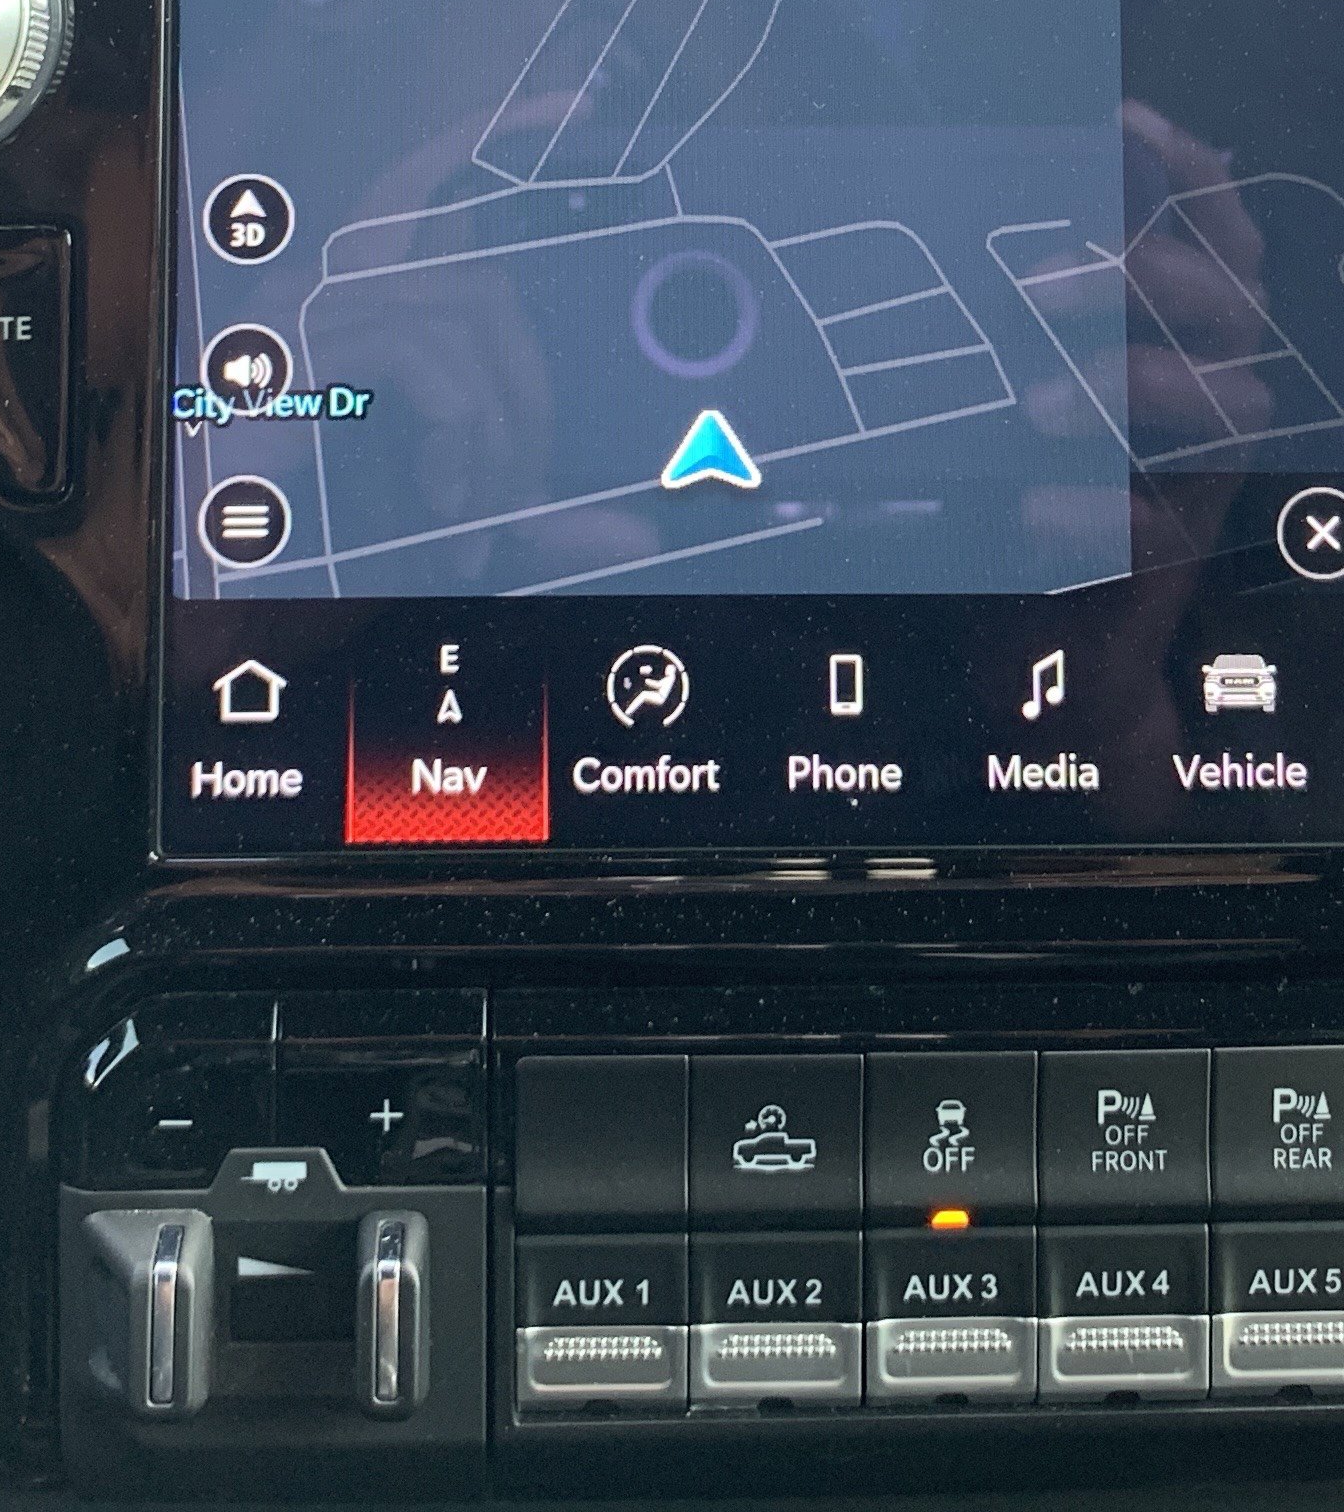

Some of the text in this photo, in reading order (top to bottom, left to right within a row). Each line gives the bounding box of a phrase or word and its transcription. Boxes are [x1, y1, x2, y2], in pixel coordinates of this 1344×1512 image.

[230, 223, 266, 248] 3D
[174, 388, 235, 425] City
[329, 387, 369, 416] Dr
[190, 761, 304, 797] Home
[411, 759, 487, 794] Nav
[573, 756, 720, 793] Comfort
[787, 755, 903, 791] Phone
[987, 755, 1099, 790] Media
[1173, 752, 1307, 789] Vehicle
[1105, 1124, 1148, 1146] OFF
[1280, 1123, 1324, 1144] OFF
[923, 1147, 976, 1173] OFF
[1092, 1149, 1168, 1172] FRONT
[1274, 1147, 1332, 1170] REAR
[554, 1280, 649, 1306] AUX 1
[727, 1279, 823, 1306] AUX 2
[904, 1274, 998, 1300] AUX 3
[1076, 1270, 1170, 1297] AUX 4
[1248, 1269, 1342, 1294] AUX 5
